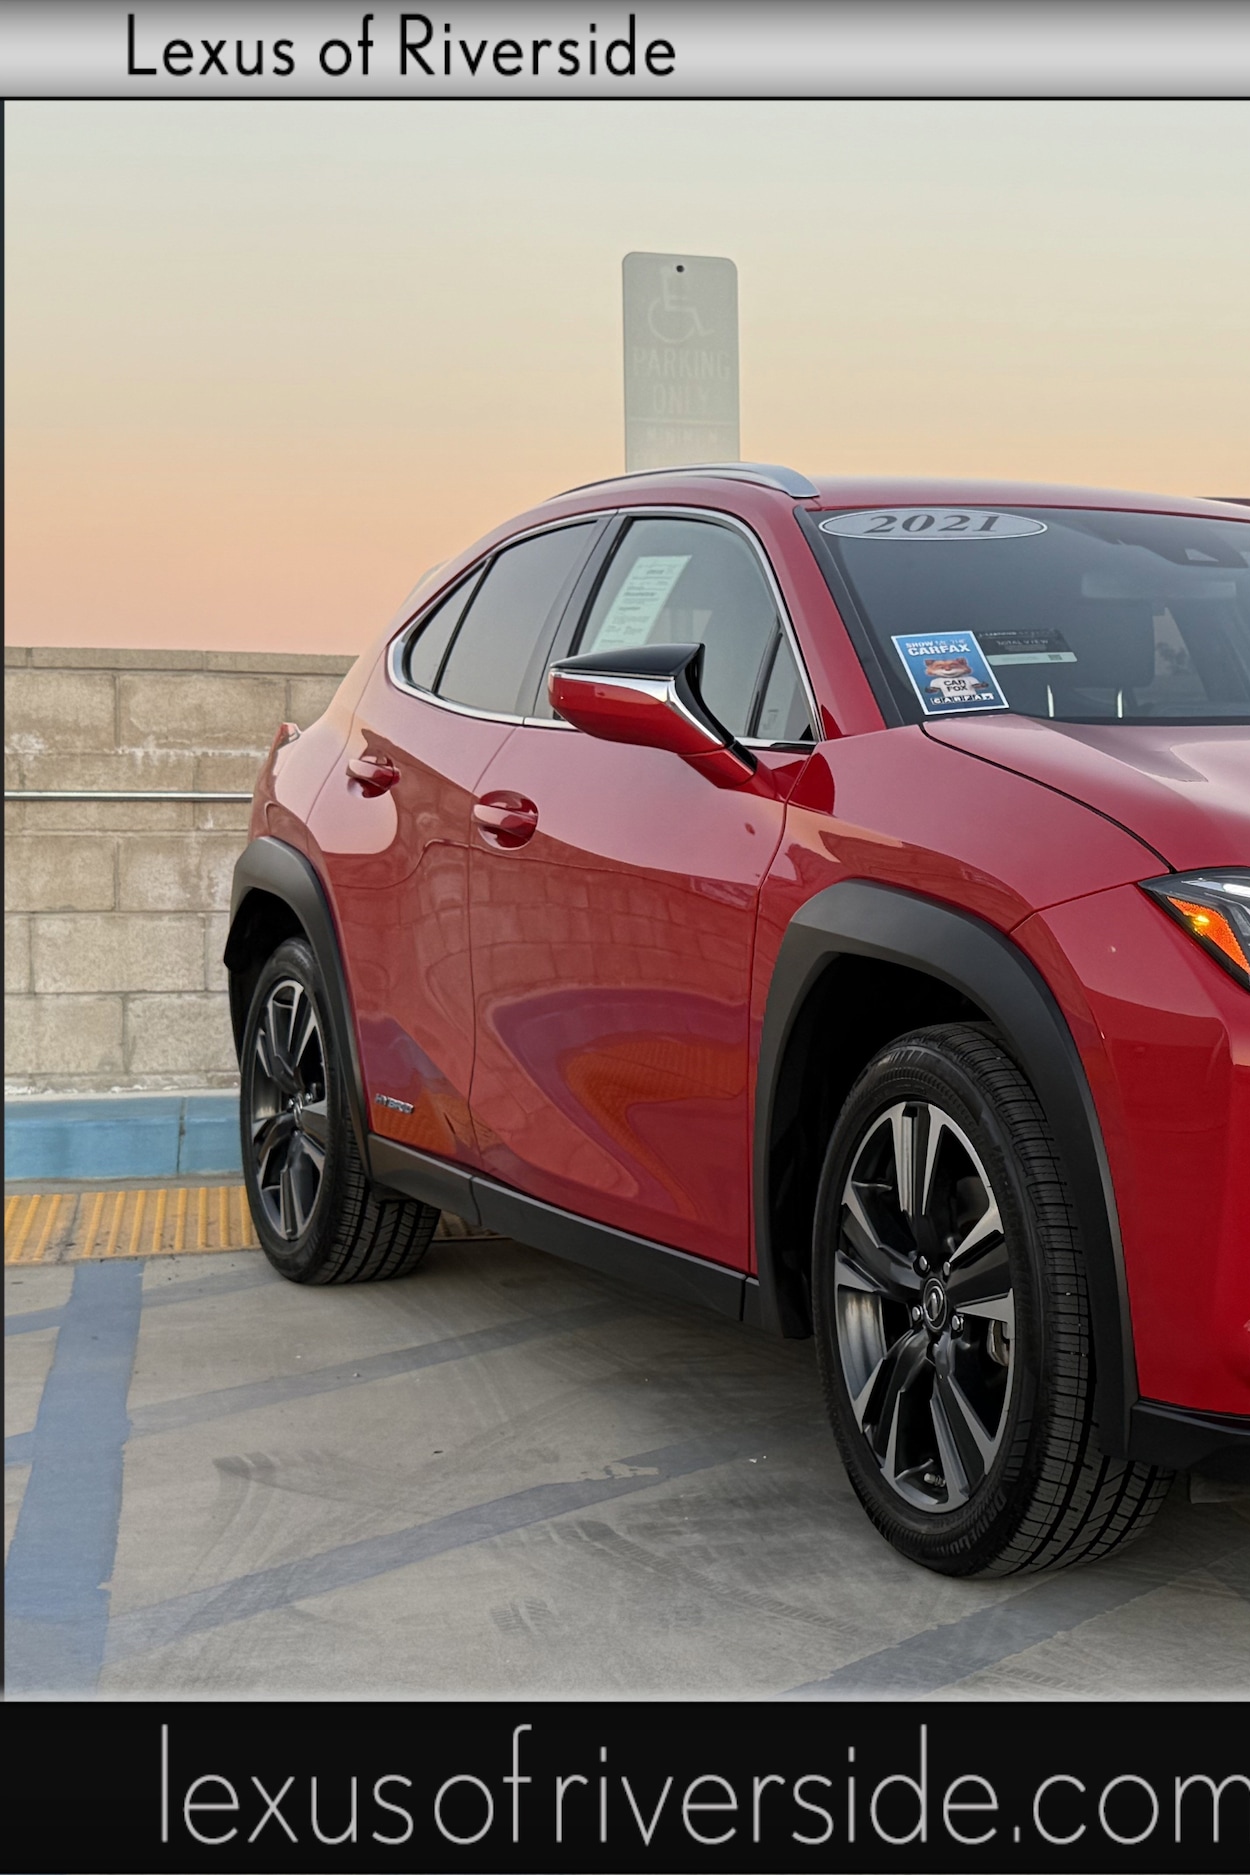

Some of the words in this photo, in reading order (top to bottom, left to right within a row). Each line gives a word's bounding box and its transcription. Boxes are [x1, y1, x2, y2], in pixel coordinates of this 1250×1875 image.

[632, 347, 731, 381] PARKING
[652, 383, 711, 415] ONLY
[863, 514, 999, 534] 2021
[908, 644, 971, 656] CARFAX
